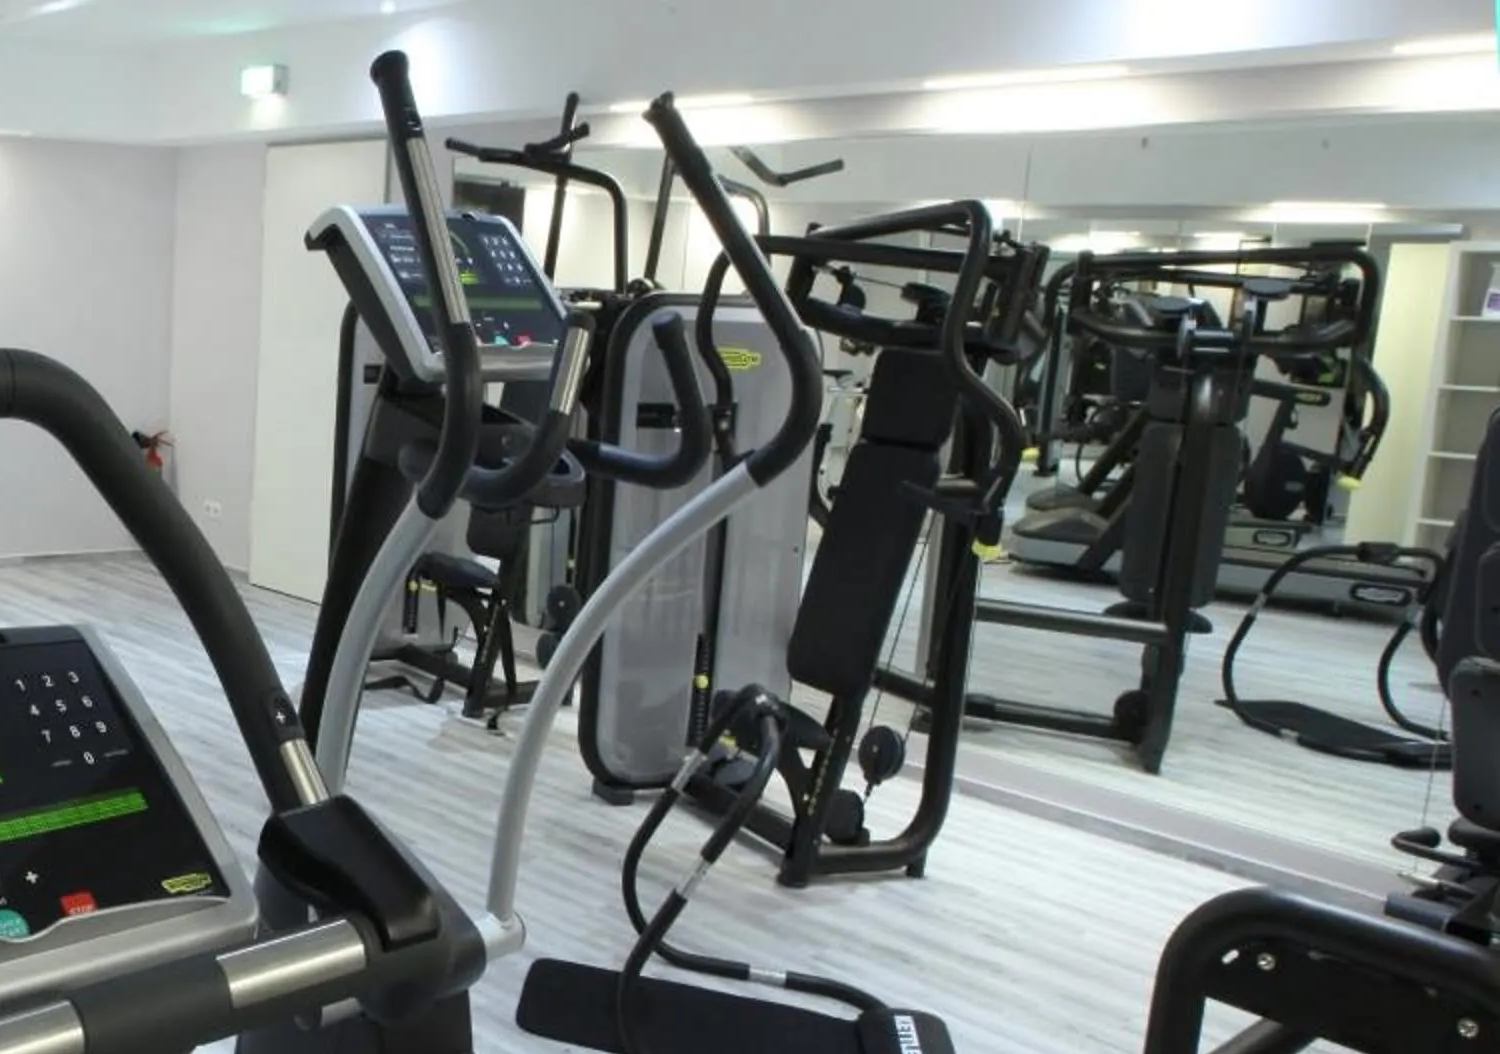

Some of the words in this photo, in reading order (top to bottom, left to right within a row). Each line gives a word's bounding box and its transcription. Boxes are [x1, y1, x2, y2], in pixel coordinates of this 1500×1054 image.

[15, 679, 26, 692] 1
[42, 675, 54, 687] 2
[68, 671, 79, 684] 3
[30, 703, 40, 716] 4
[55, 699, 67, 712] 5
[81, 695, 93, 708] 6
[41, 729, 51, 744] 7
[69, 725, 80, 738] 8
[95, 720, 107, 733] 9
[83, 751, 95, 765] 0
